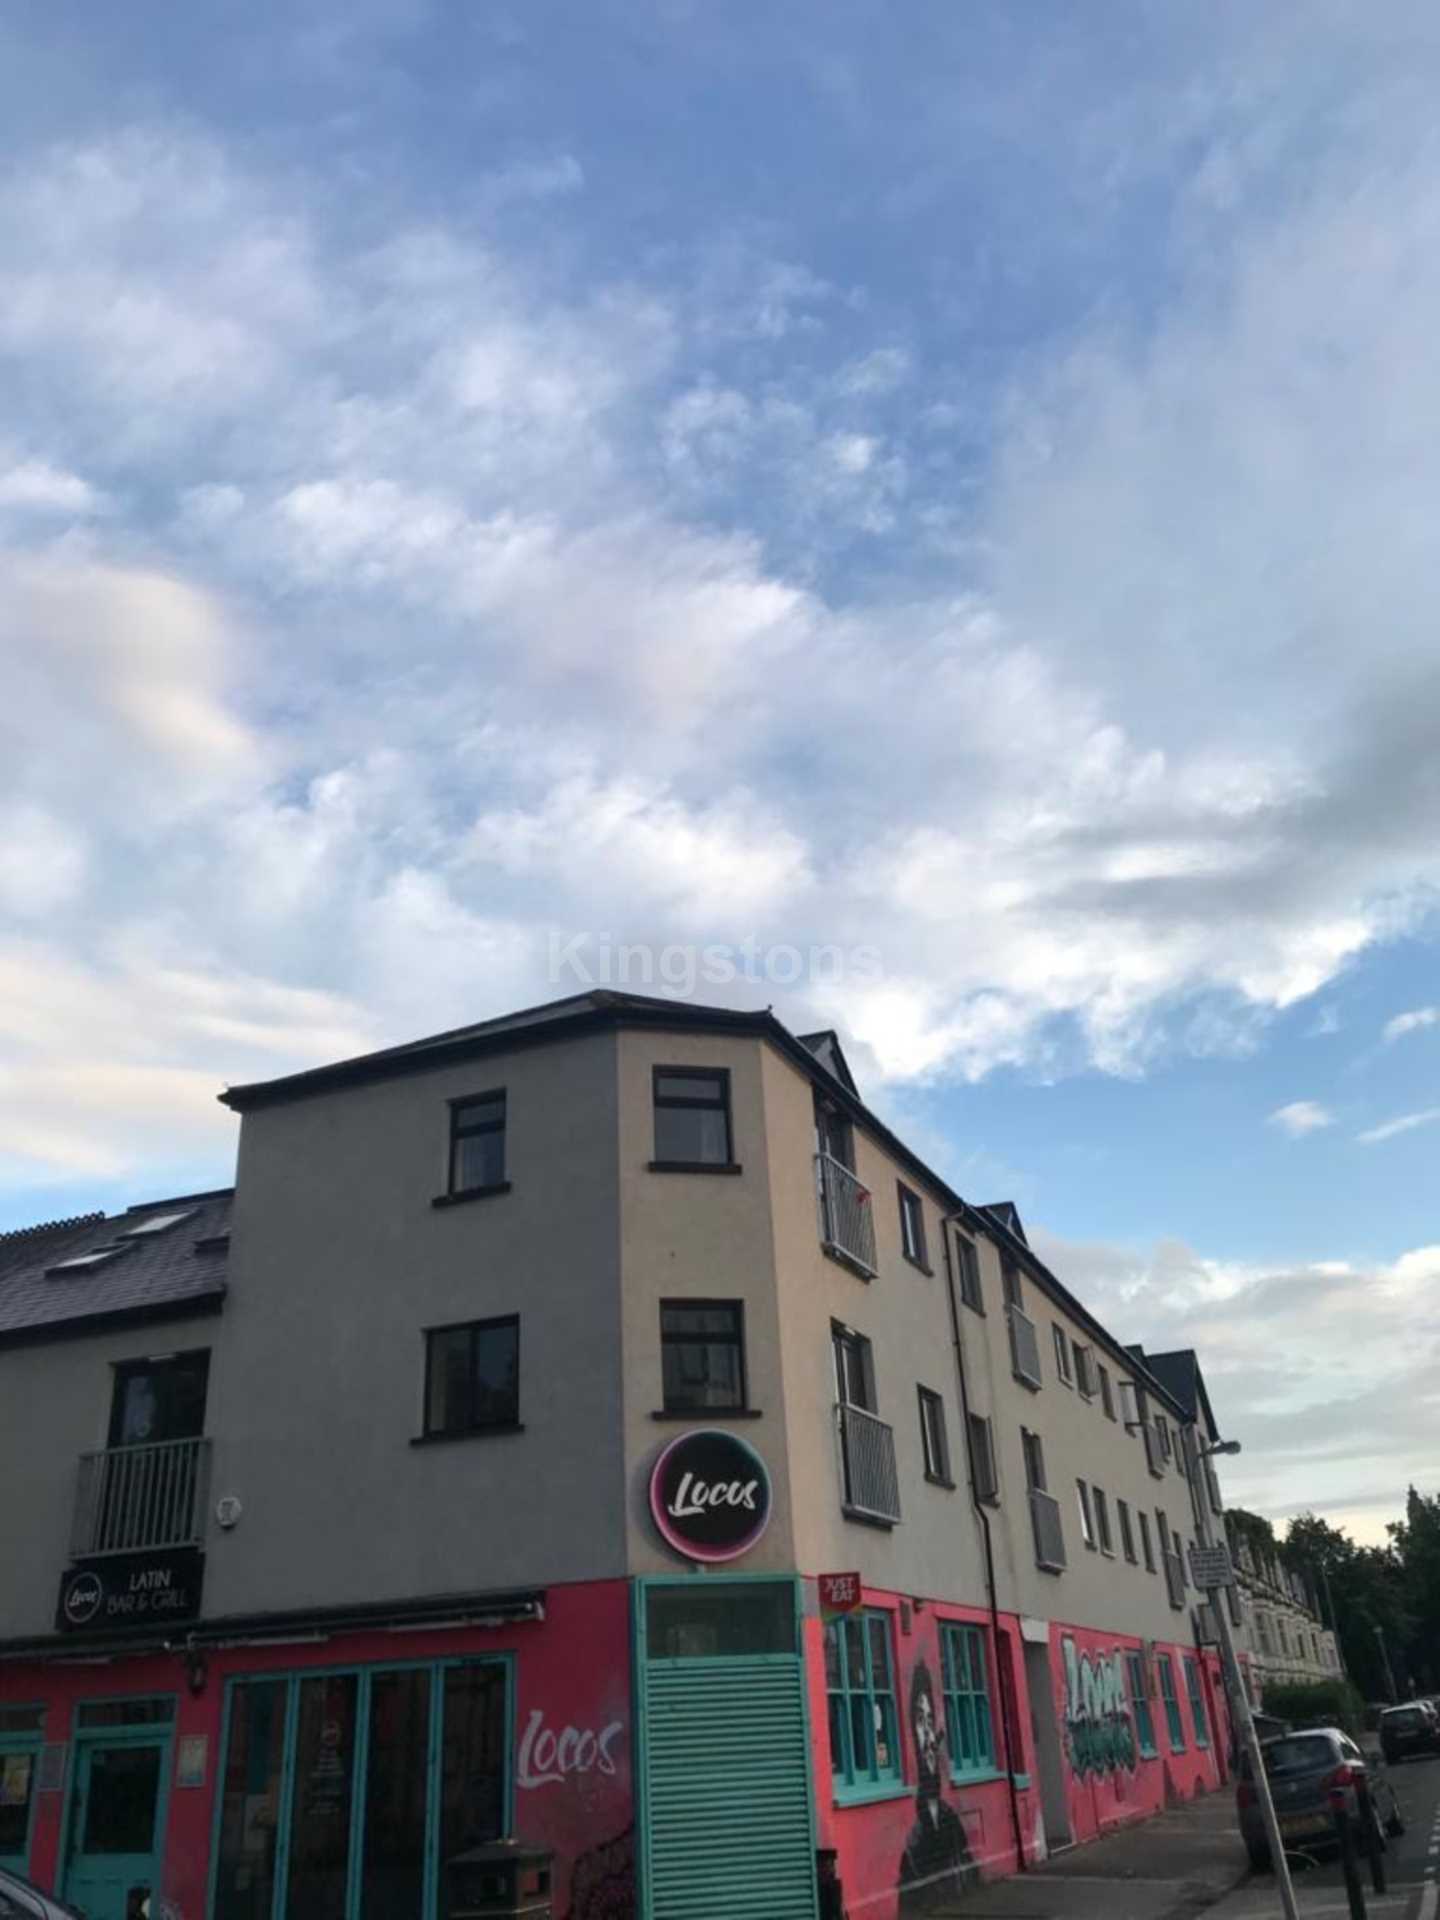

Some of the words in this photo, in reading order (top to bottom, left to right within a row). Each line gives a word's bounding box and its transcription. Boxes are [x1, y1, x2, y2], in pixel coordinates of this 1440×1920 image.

[129, 1569, 172, 1591] LATIN
[824, 1577, 855, 1592] JUST
[107, 1594, 134, 1615] BAR
[831, 1589, 856, 1602] EAT
